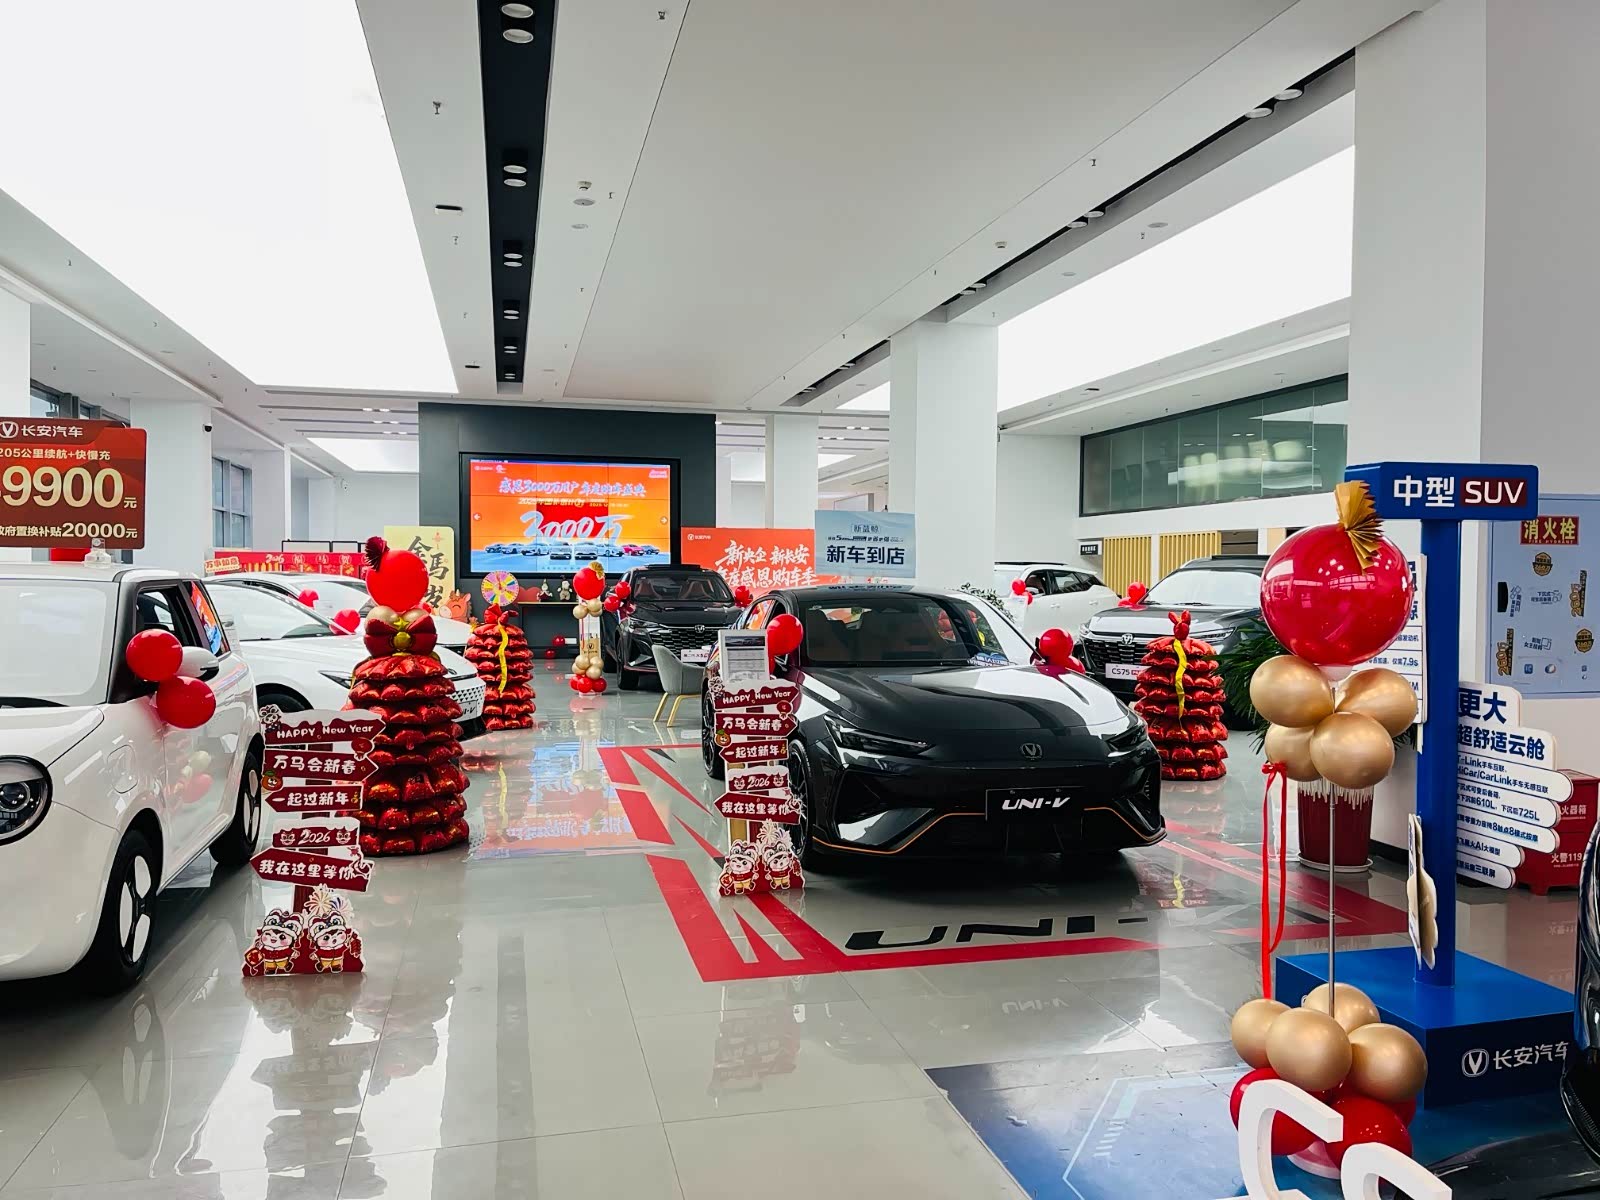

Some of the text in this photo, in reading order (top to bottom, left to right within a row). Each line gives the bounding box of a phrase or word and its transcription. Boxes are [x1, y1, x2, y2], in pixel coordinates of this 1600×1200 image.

[21, 425, 83, 438] 长安汽车
[0, 465, 137, 509] 9900元
[1393, 475, 1525, 508] 中型 SUV
[520, 510, 635, 545] 3000万
[1523, 517, 1576, 540] 消火栓
[715, 540, 810, 569] 新央企 新长安
[826, 545, 905, 565] 新车到店
[716, 566, 817, 588] 年度感恩购车季
[1111, 668, 1130, 676] CS75
[722, 694, 750, 704] HAPPY
[773, 690, 791, 698] Year
[1458, 687, 1507, 724] 更大
[276, 724, 373, 738] HAPPY New Year
[722, 717, 782, 731] 万马会新春
[1458, 724, 1545, 761] 超舒适云舱
[724, 745, 779, 759] 一起过新年
[273, 755, 356, 774] 万马会新春
[747, 776, 770, 789] 2026
[272, 792, 349, 806] 一起过新年
[1001, 797, 1071, 810] UNI-V
[721, 801, 790, 816] 我在这里等你
[1560, 805, 1587, 815] 火器箱
[298, 828, 331, 845] 2026
[1551, 852, 1583, 863] 火警119
[259, 859, 354, 880] 我在这里等你
[1493, 1041, 1569, 1070] 长安汽车
